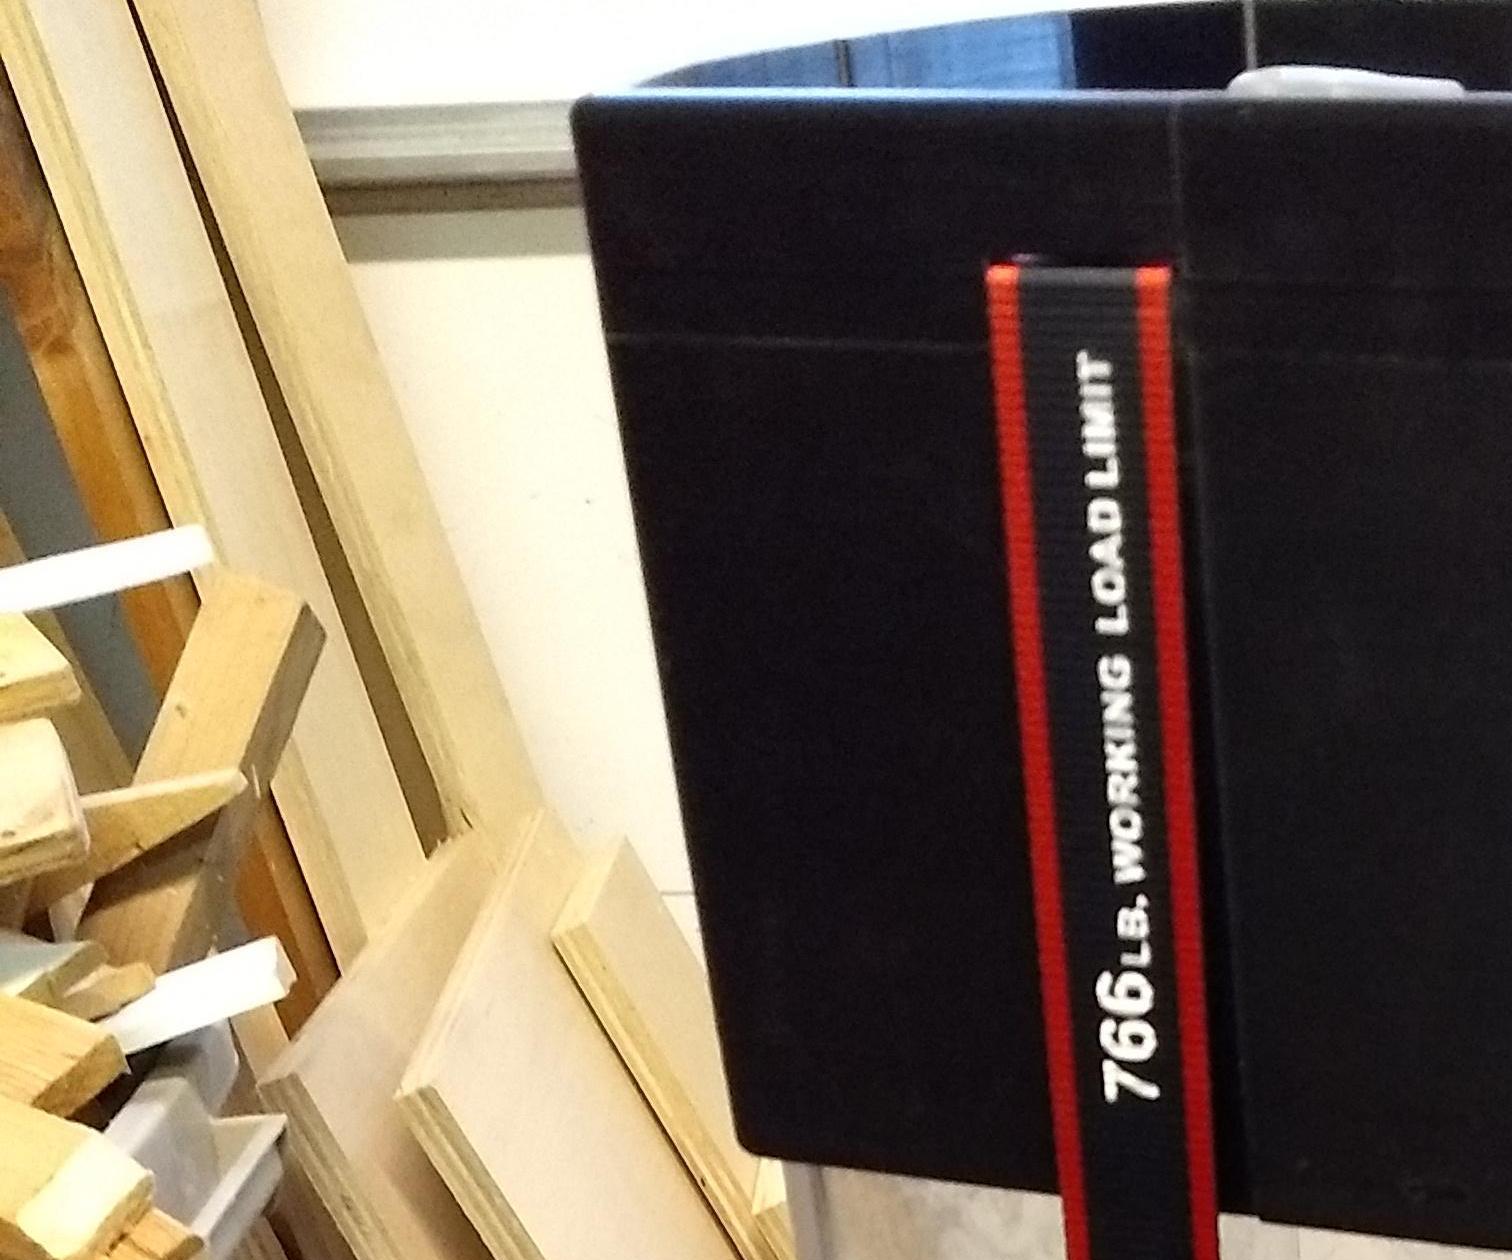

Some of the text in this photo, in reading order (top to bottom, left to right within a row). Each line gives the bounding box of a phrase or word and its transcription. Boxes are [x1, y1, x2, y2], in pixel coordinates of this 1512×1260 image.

[1076, 348, 1160, 1103] 766 LB. WORKING LOAD LIMIT
